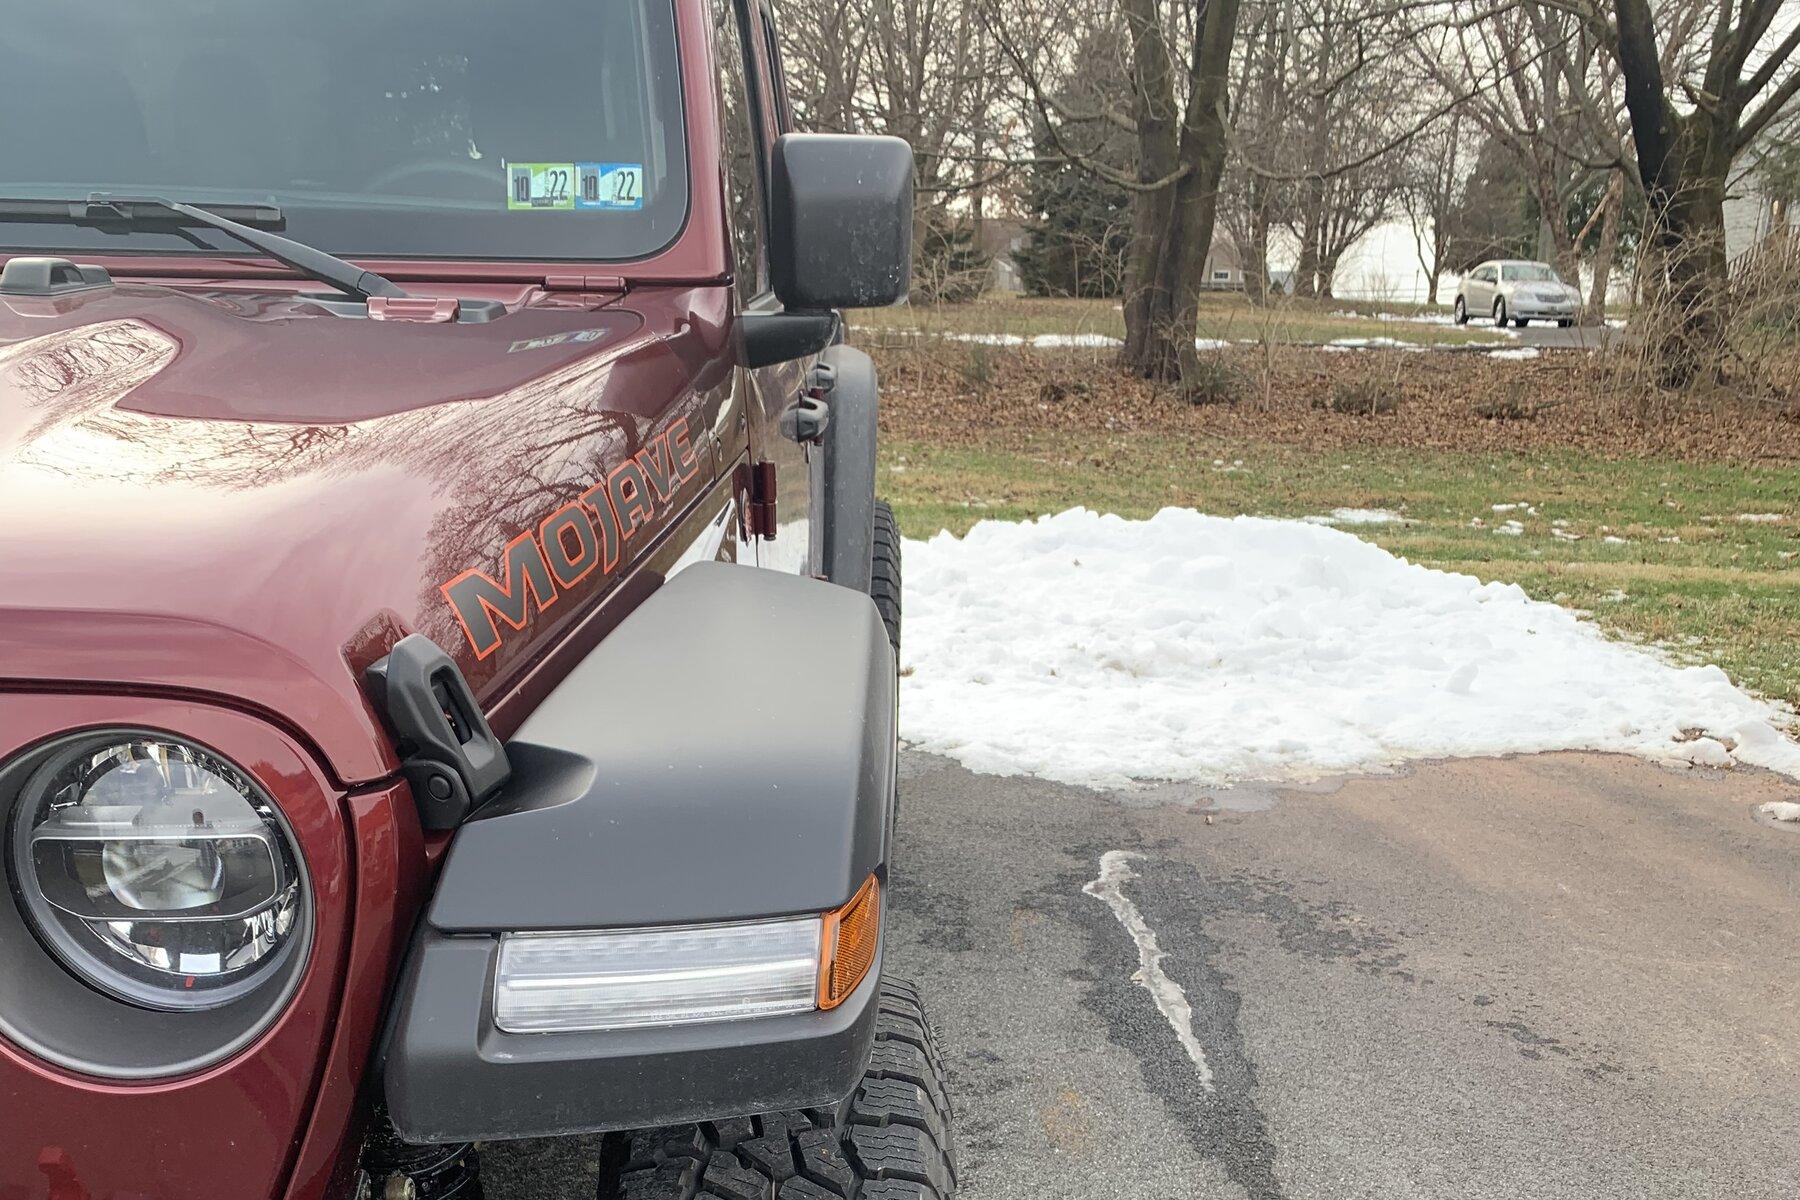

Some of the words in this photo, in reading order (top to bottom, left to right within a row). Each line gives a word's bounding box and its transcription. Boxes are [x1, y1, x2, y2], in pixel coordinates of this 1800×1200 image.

[549, 170, 568, 201] 22
[617, 171, 635, 201] 22
[439, 416, 700, 661] MOJAVE
